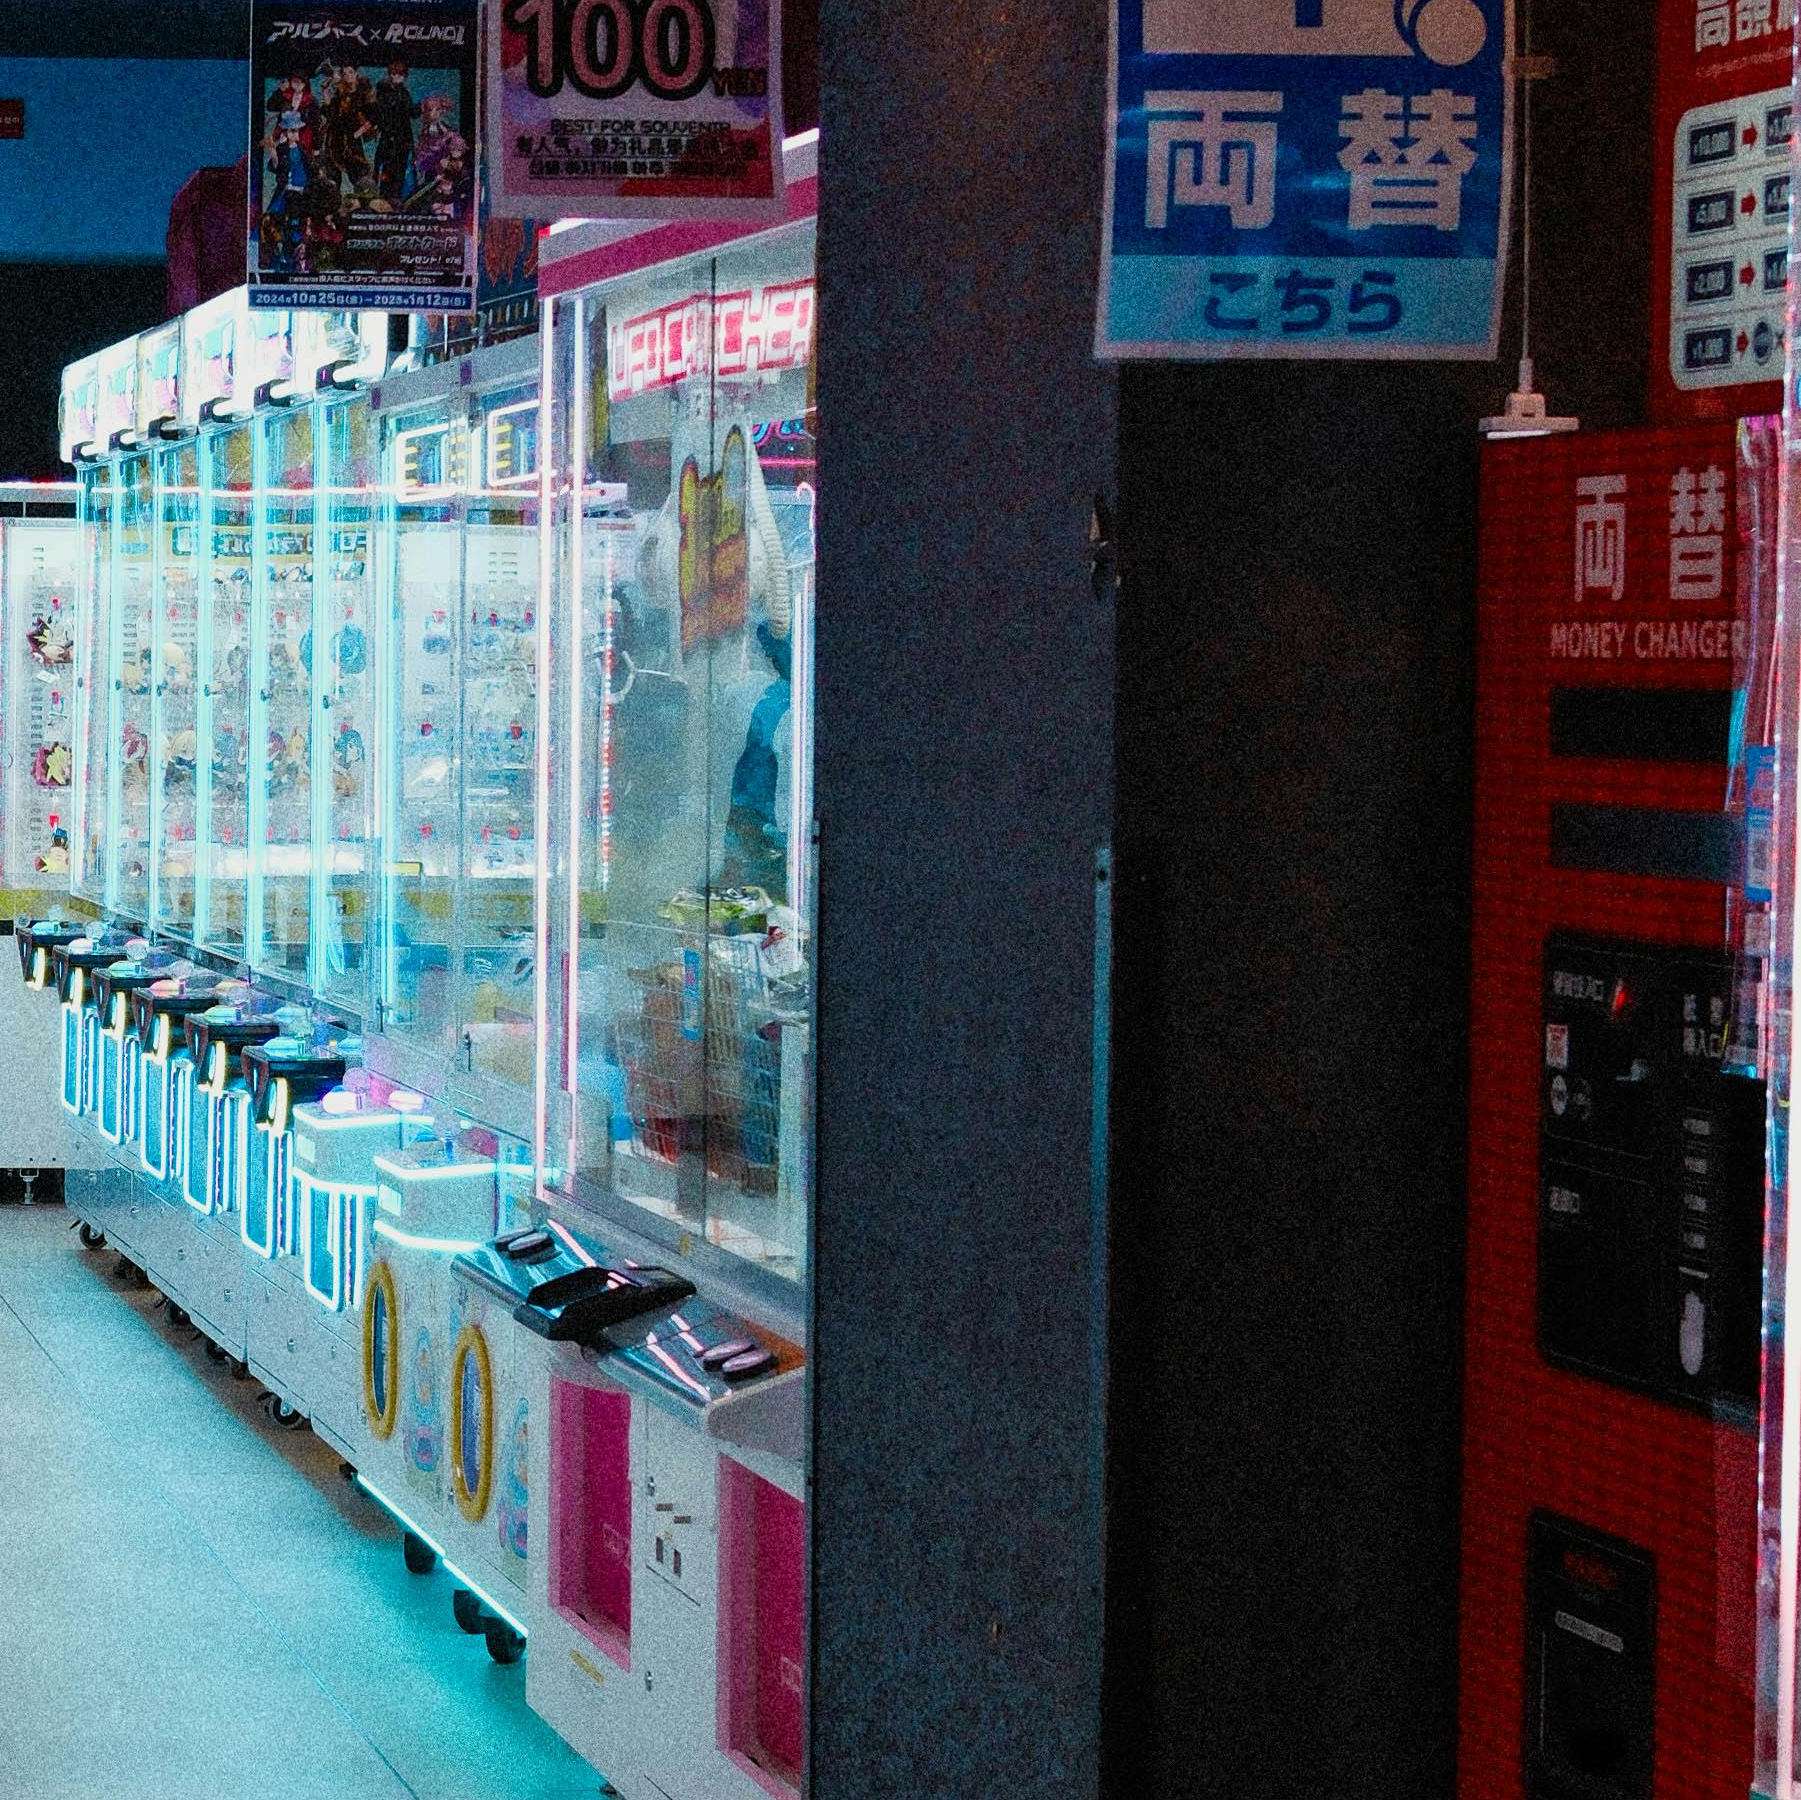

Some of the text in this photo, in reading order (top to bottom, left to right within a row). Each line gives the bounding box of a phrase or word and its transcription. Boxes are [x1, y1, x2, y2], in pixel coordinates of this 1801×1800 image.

[711, 68, 767, 96] YEN
[550, 118, 731, 136] BEST FOR SOUVENIR
[1143, 86, 1479, 232] 両替
[1203, 269, 1402, 334] こちら
[1574, 464, 1726, 602] 両替
[1550, 620, 1746, 659] MONEY CHANGER
